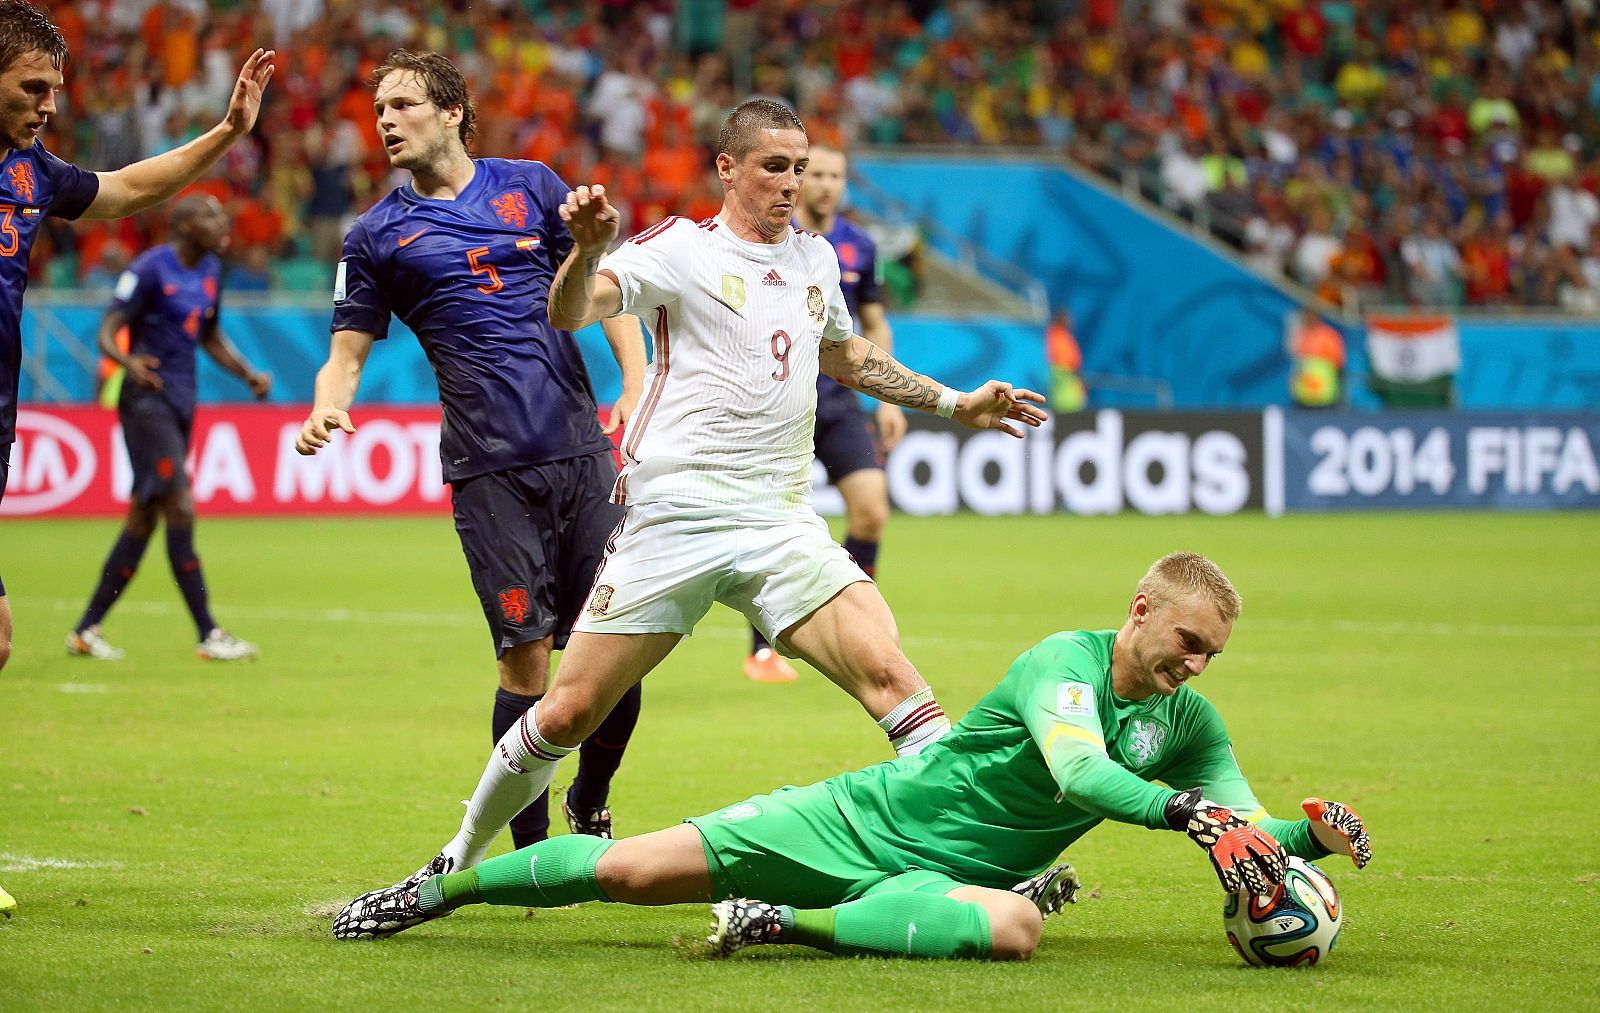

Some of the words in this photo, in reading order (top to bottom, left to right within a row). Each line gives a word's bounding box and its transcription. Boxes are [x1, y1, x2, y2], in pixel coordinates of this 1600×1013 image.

[0, 204, 19, 257] 3
[465, 246, 504, 295] 5
[761, 279, 787, 287] adidas
[770, 329, 792, 382] 9
[274, 420, 446, 503] MOT
[886, 407, 1251, 516] adidas
[1307, 426, 1456, 496] 2014
[1466, 426, 1600, 495] FIFA
